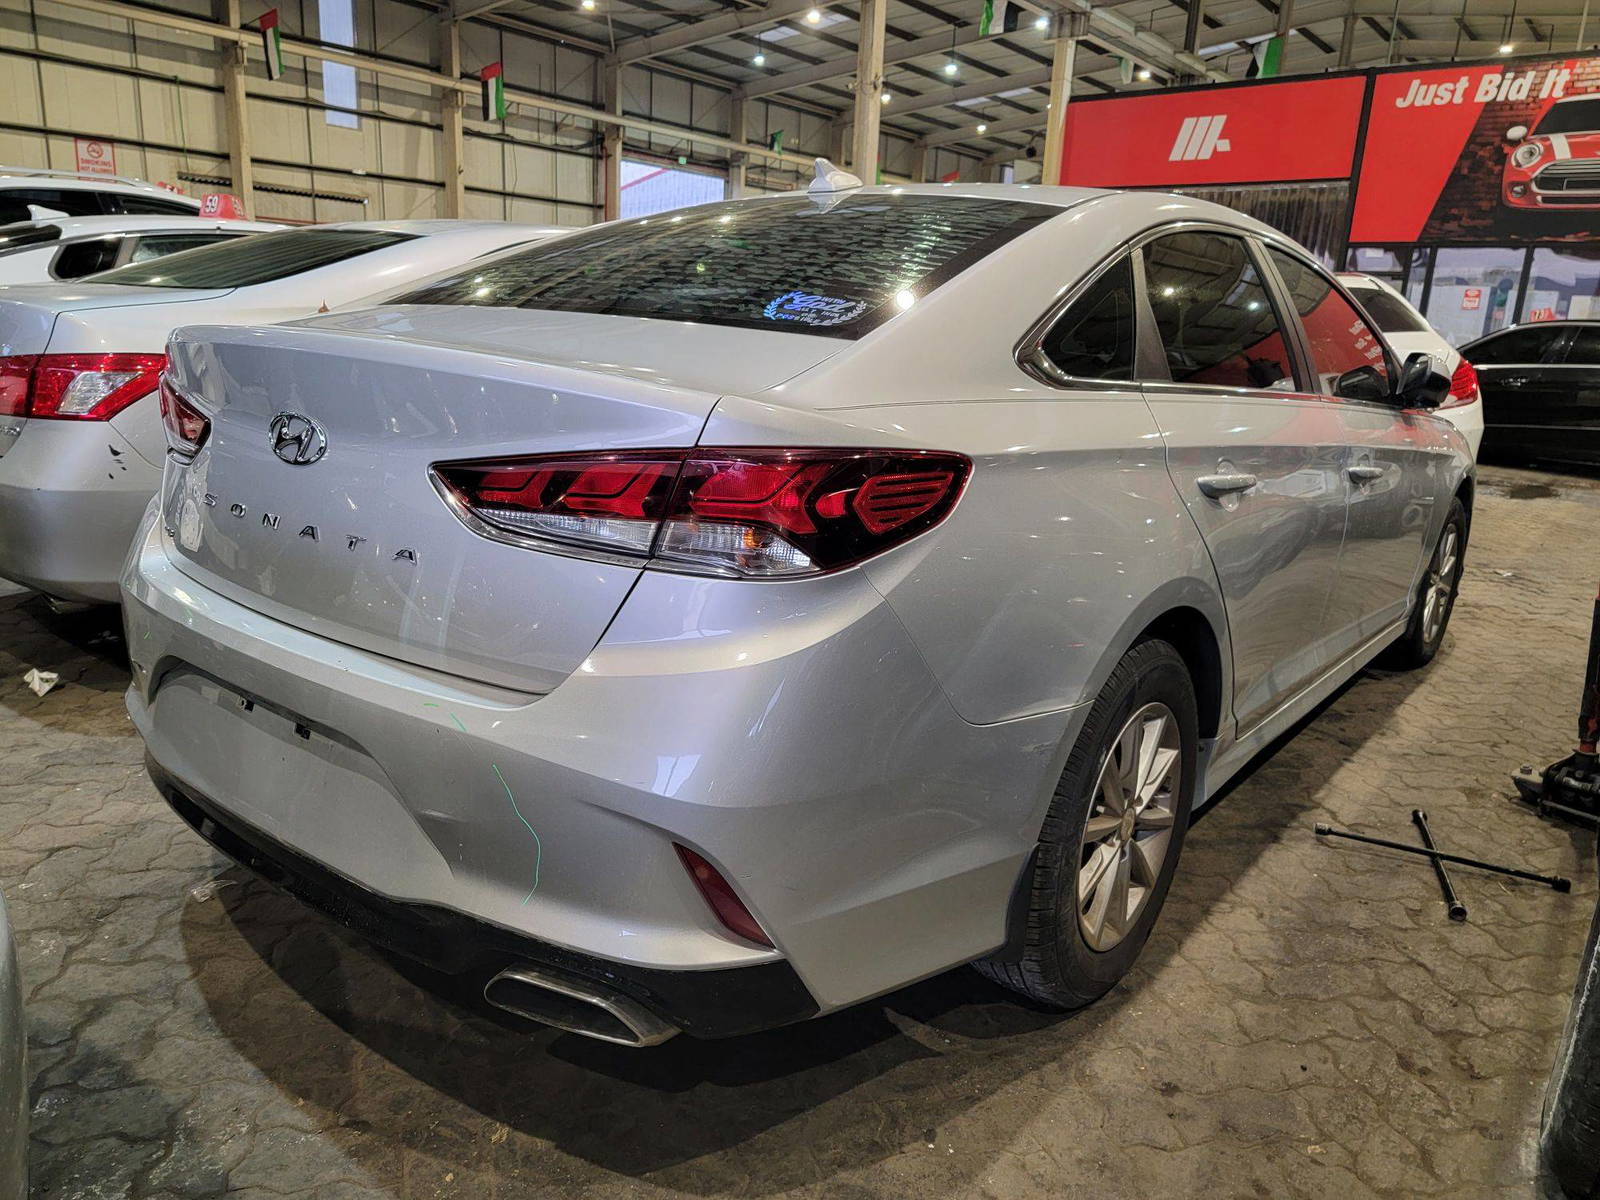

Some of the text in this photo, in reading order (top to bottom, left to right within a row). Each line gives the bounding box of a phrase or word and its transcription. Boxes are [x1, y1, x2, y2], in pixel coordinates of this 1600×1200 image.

[1395, 68, 1571, 108] Just Bid It
[204, 195, 219, 213] 59
[203, 493, 418, 566] SONATA
